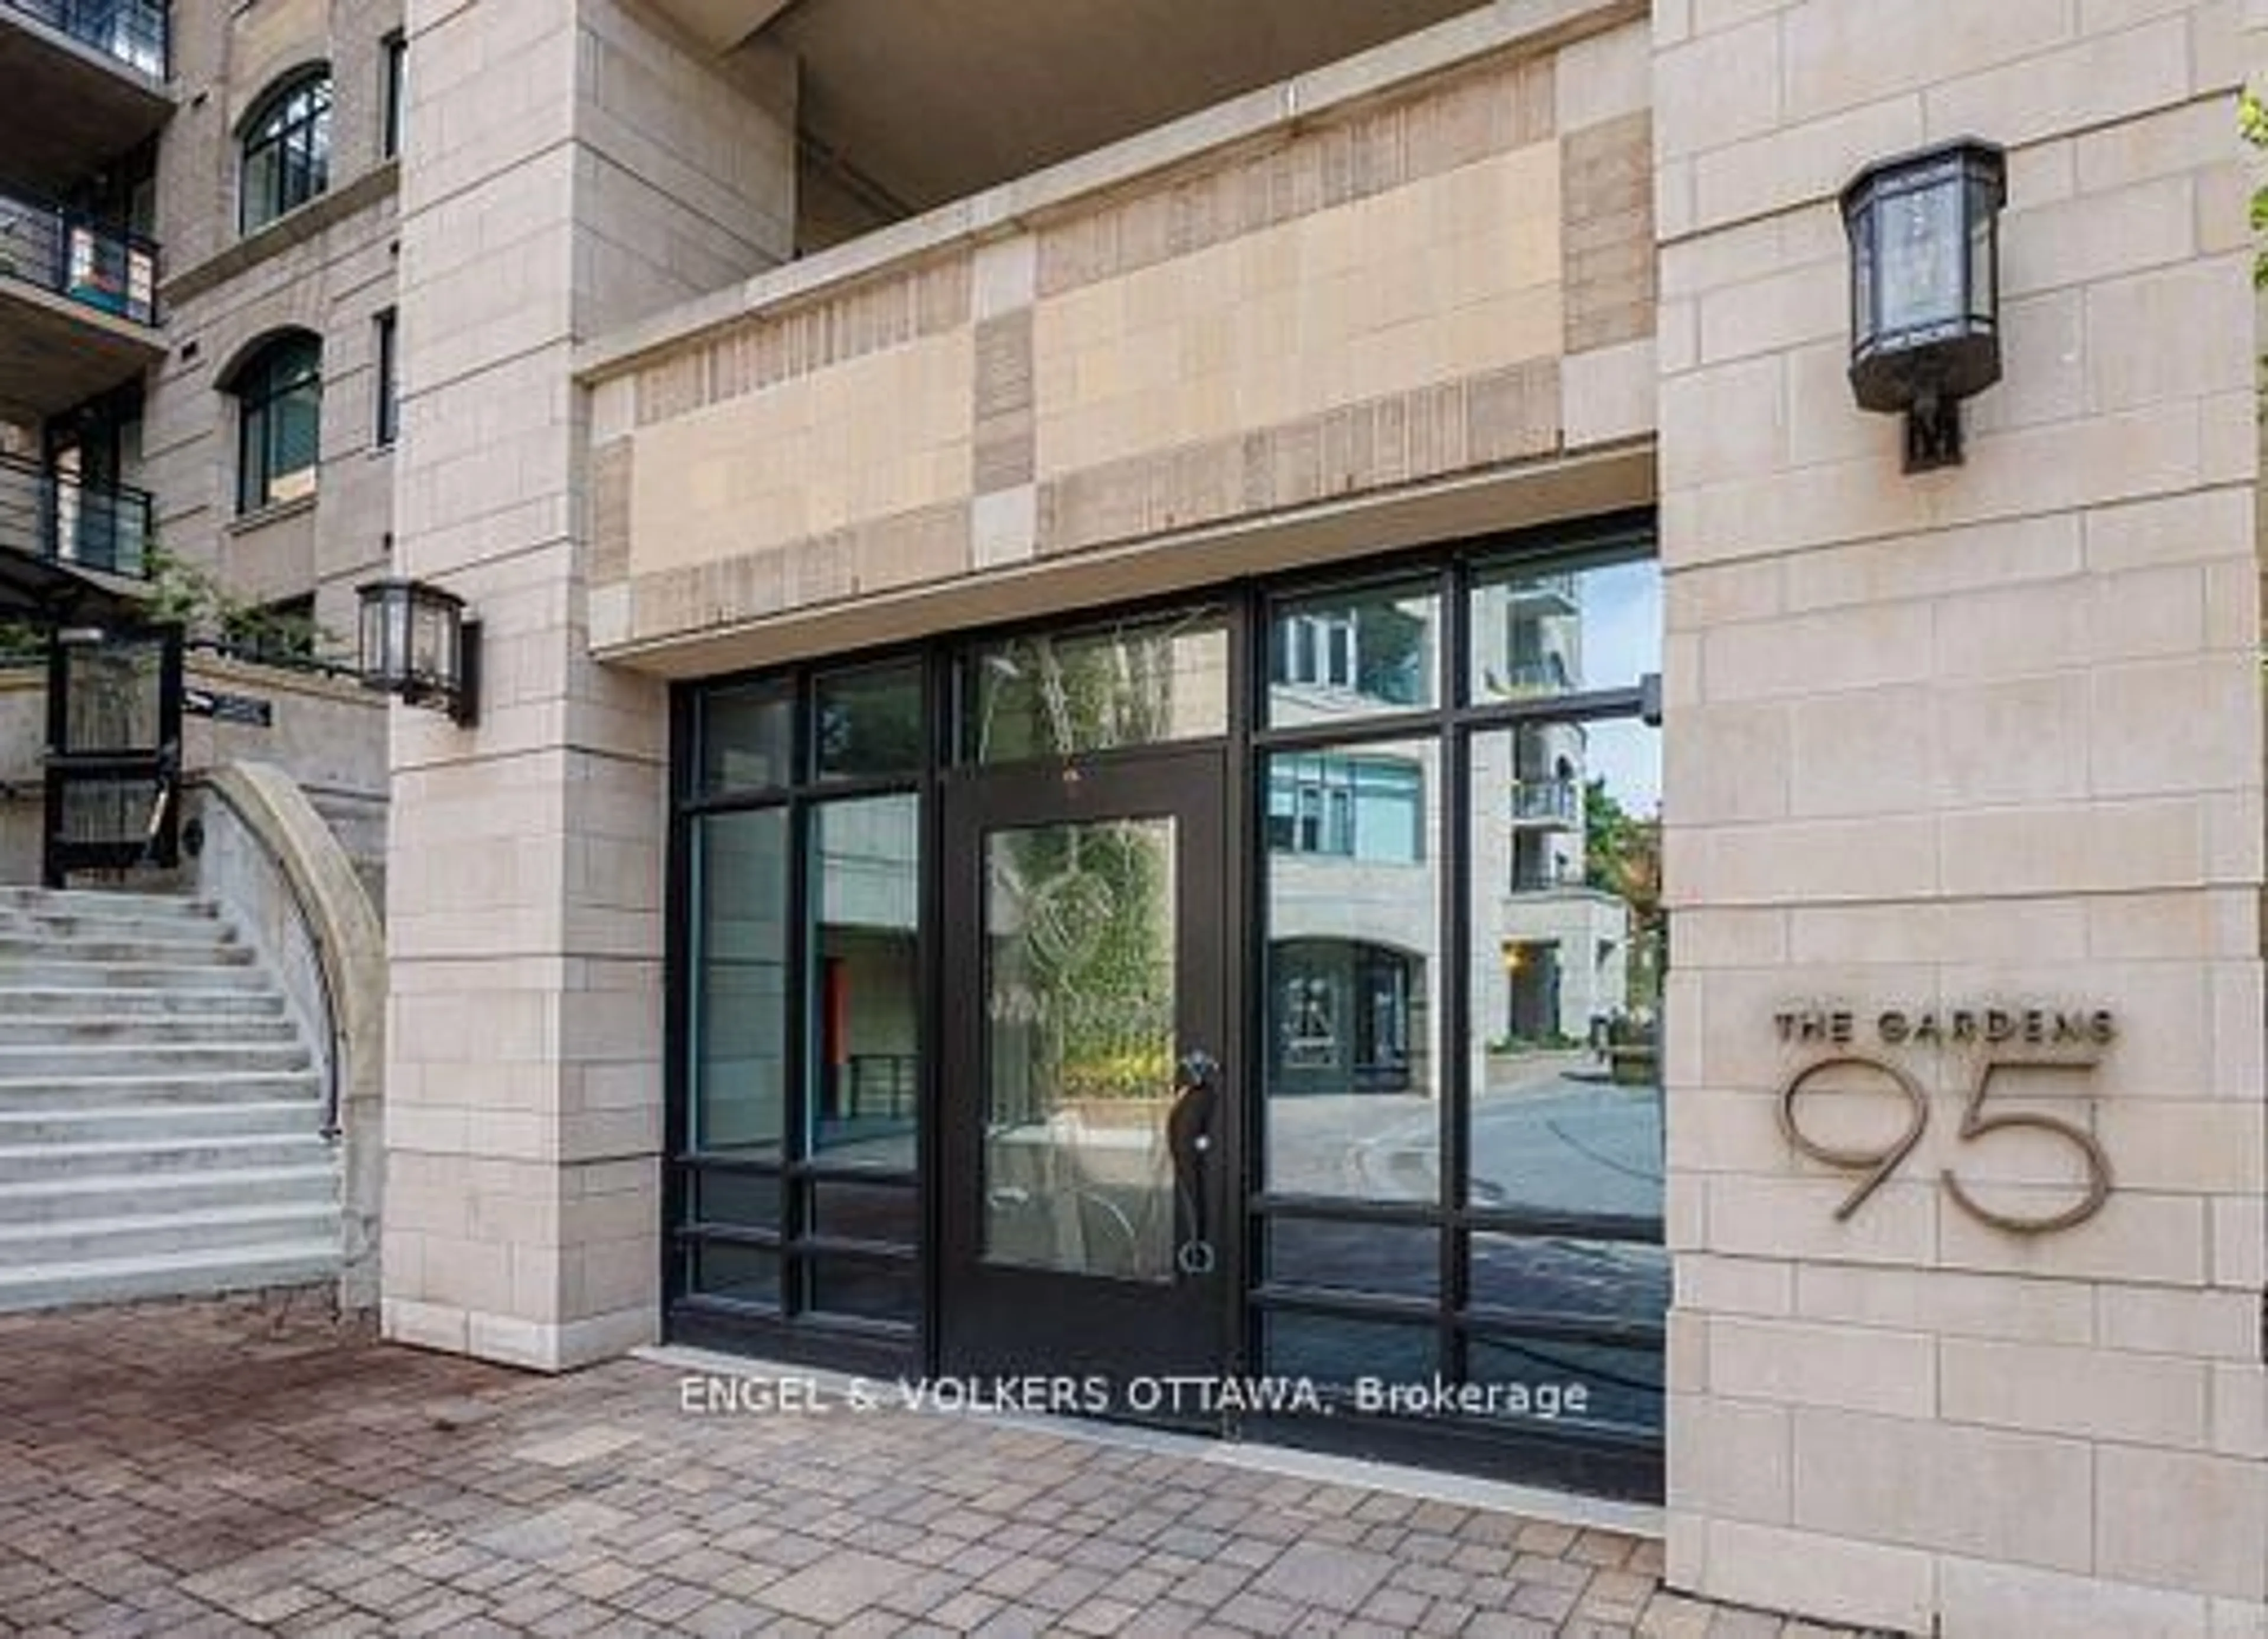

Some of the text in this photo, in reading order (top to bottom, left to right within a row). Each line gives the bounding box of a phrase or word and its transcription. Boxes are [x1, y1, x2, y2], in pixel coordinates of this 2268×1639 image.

[1774, 1009, 2117, 1045] THE GARDENS
[1778, 1056, 2116, 1234] 95
